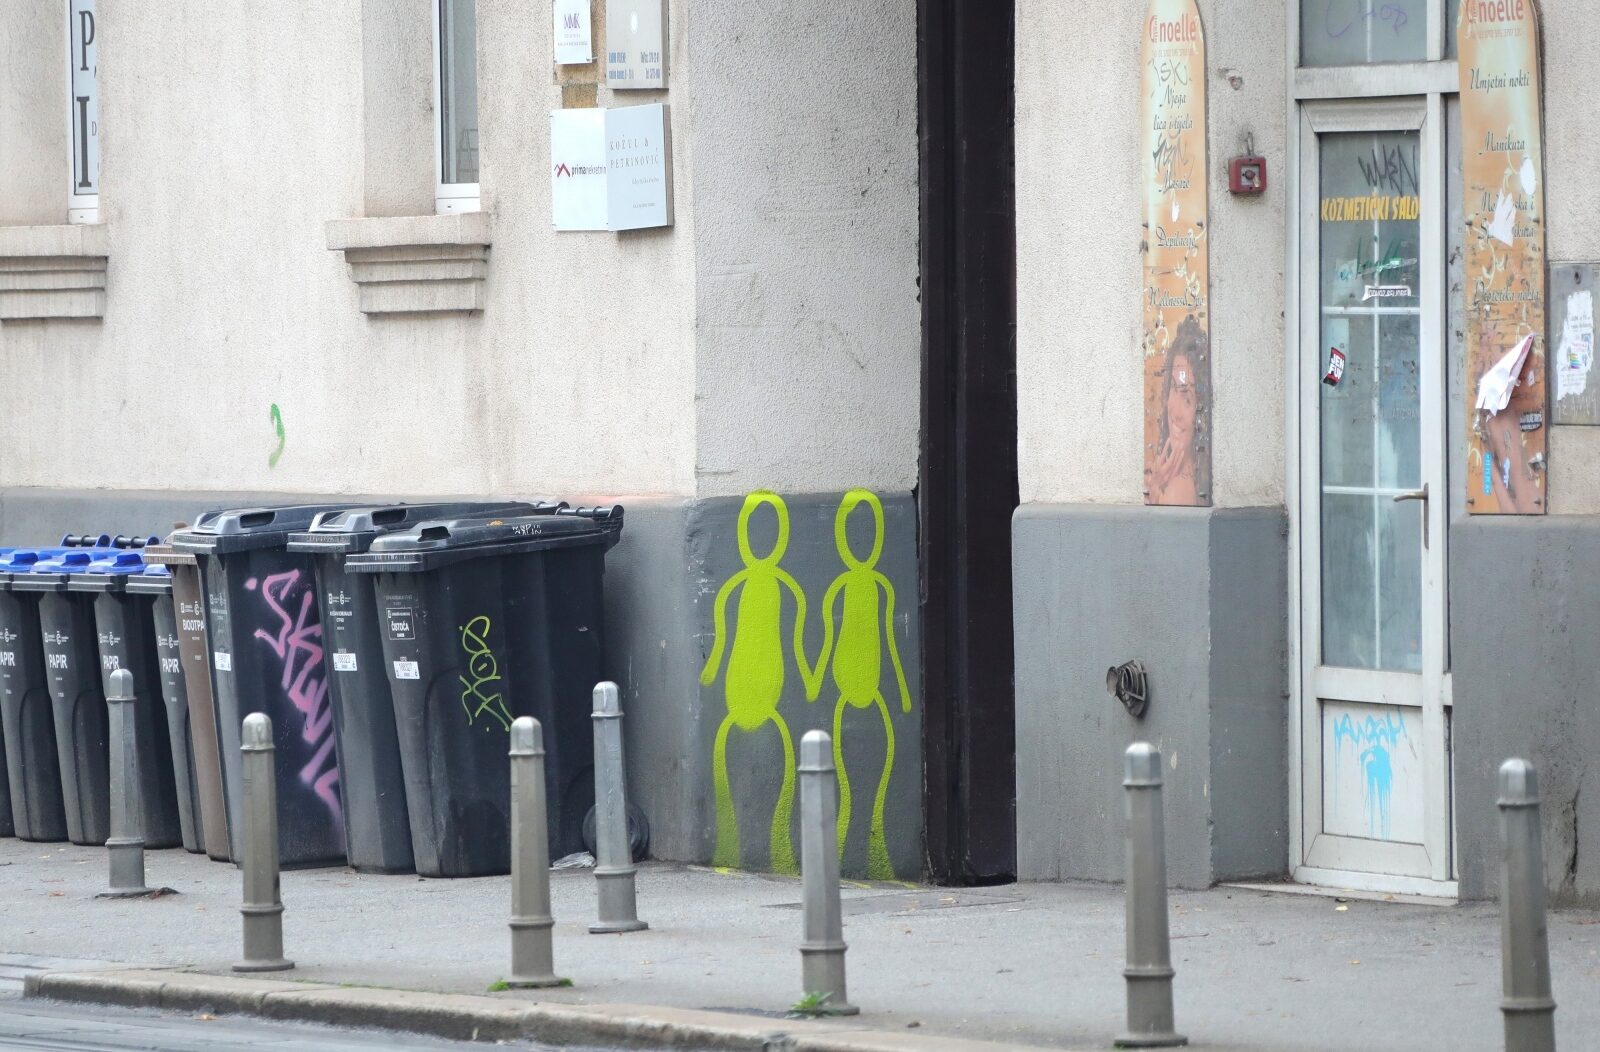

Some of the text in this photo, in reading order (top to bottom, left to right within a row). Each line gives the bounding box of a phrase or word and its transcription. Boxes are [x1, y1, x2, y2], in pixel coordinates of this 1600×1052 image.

[1470, 68, 1530, 93] Umjetni nokti
[1153, 115, 1167, 130] lica
[1321, 192, 1389, 221] KOZMETIČKI
[48, 654, 68, 669] PAPIR
[103, 655, 120, 670] PAPIR
[162, 657, 180, 673] PAPIR
